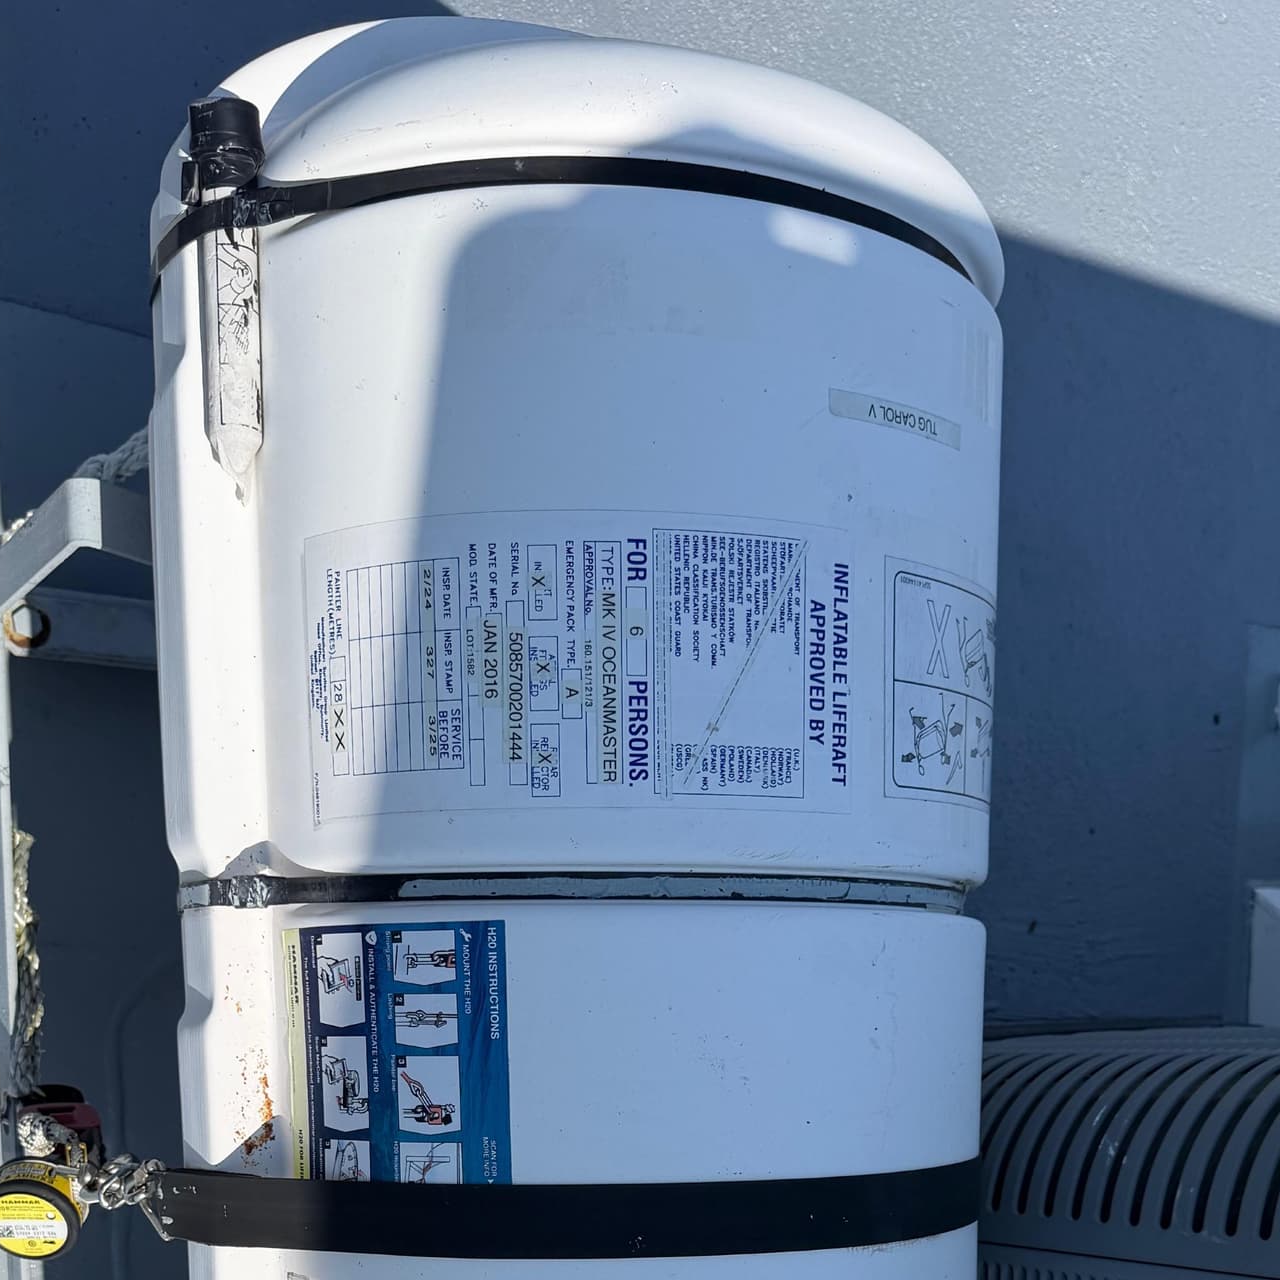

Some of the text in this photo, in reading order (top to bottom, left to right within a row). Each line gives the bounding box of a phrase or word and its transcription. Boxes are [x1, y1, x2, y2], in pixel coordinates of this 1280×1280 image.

[868, 404, 937, 436] TUG CAROL V
[488, 543, 497, 569] DATE
[511, 541, 519, 577] SERIAL
[565, 540, 575, 602] EMERGENCY
[585, 544, 595, 598] APPROVAL
[334, 571, 342, 612] PAINTER
[422, 569, 433, 611] 2/24
[488, 571, 498, 585] OF
[443, 594, 452, 620] DATE
[602, 593, 616, 620] MK
[746, 593, 752, 604] OF
[483, 620, 498, 654] JAN
[566, 604, 576, 633] PACK
[602, 625, 616, 642] IV
[426, 646, 435, 680] 327
[466, 629, 476, 677] LOT:1582
[627, 538, 649, 787] FOR 6 PERSONS.
[444, 660, 454, 695] STAMP
[484, 658, 499, 700] 2016
[809, 600, 826, 745] APPROVED BY
[831, 563, 849, 787] INFLATABLE LIFERAFT
[333, 684, 343, 703] 28
[508, 632, 524, 761] 5085700201444
[566, 687, 580, 699] A
[602, 646, 617, 783] OCEANMASTER
[428, 716, 438, 757] 3/25
[439, 710, 450, 760] BEFORE
[451, 709, 462, 761] SERVICE
[728, 745, 736, 782] (POLAND)
[736, 746, 744, 784] (SWEDEN)
[785, 748, 793, 784] (FRANCE)
[367, 949, 376, 982] INSTALL
[462, 944, 471, 976] MOUNT
[463, 977, 471, 996] THE
[487, 952, 500, 1040] INSTRUCTIONS
[370, 994, 379, 1056] AUTHENTICATE
[482, 1137, 491, 1177] MORE INFO
[489, 1140, 498, 1177] SCAN FOR
